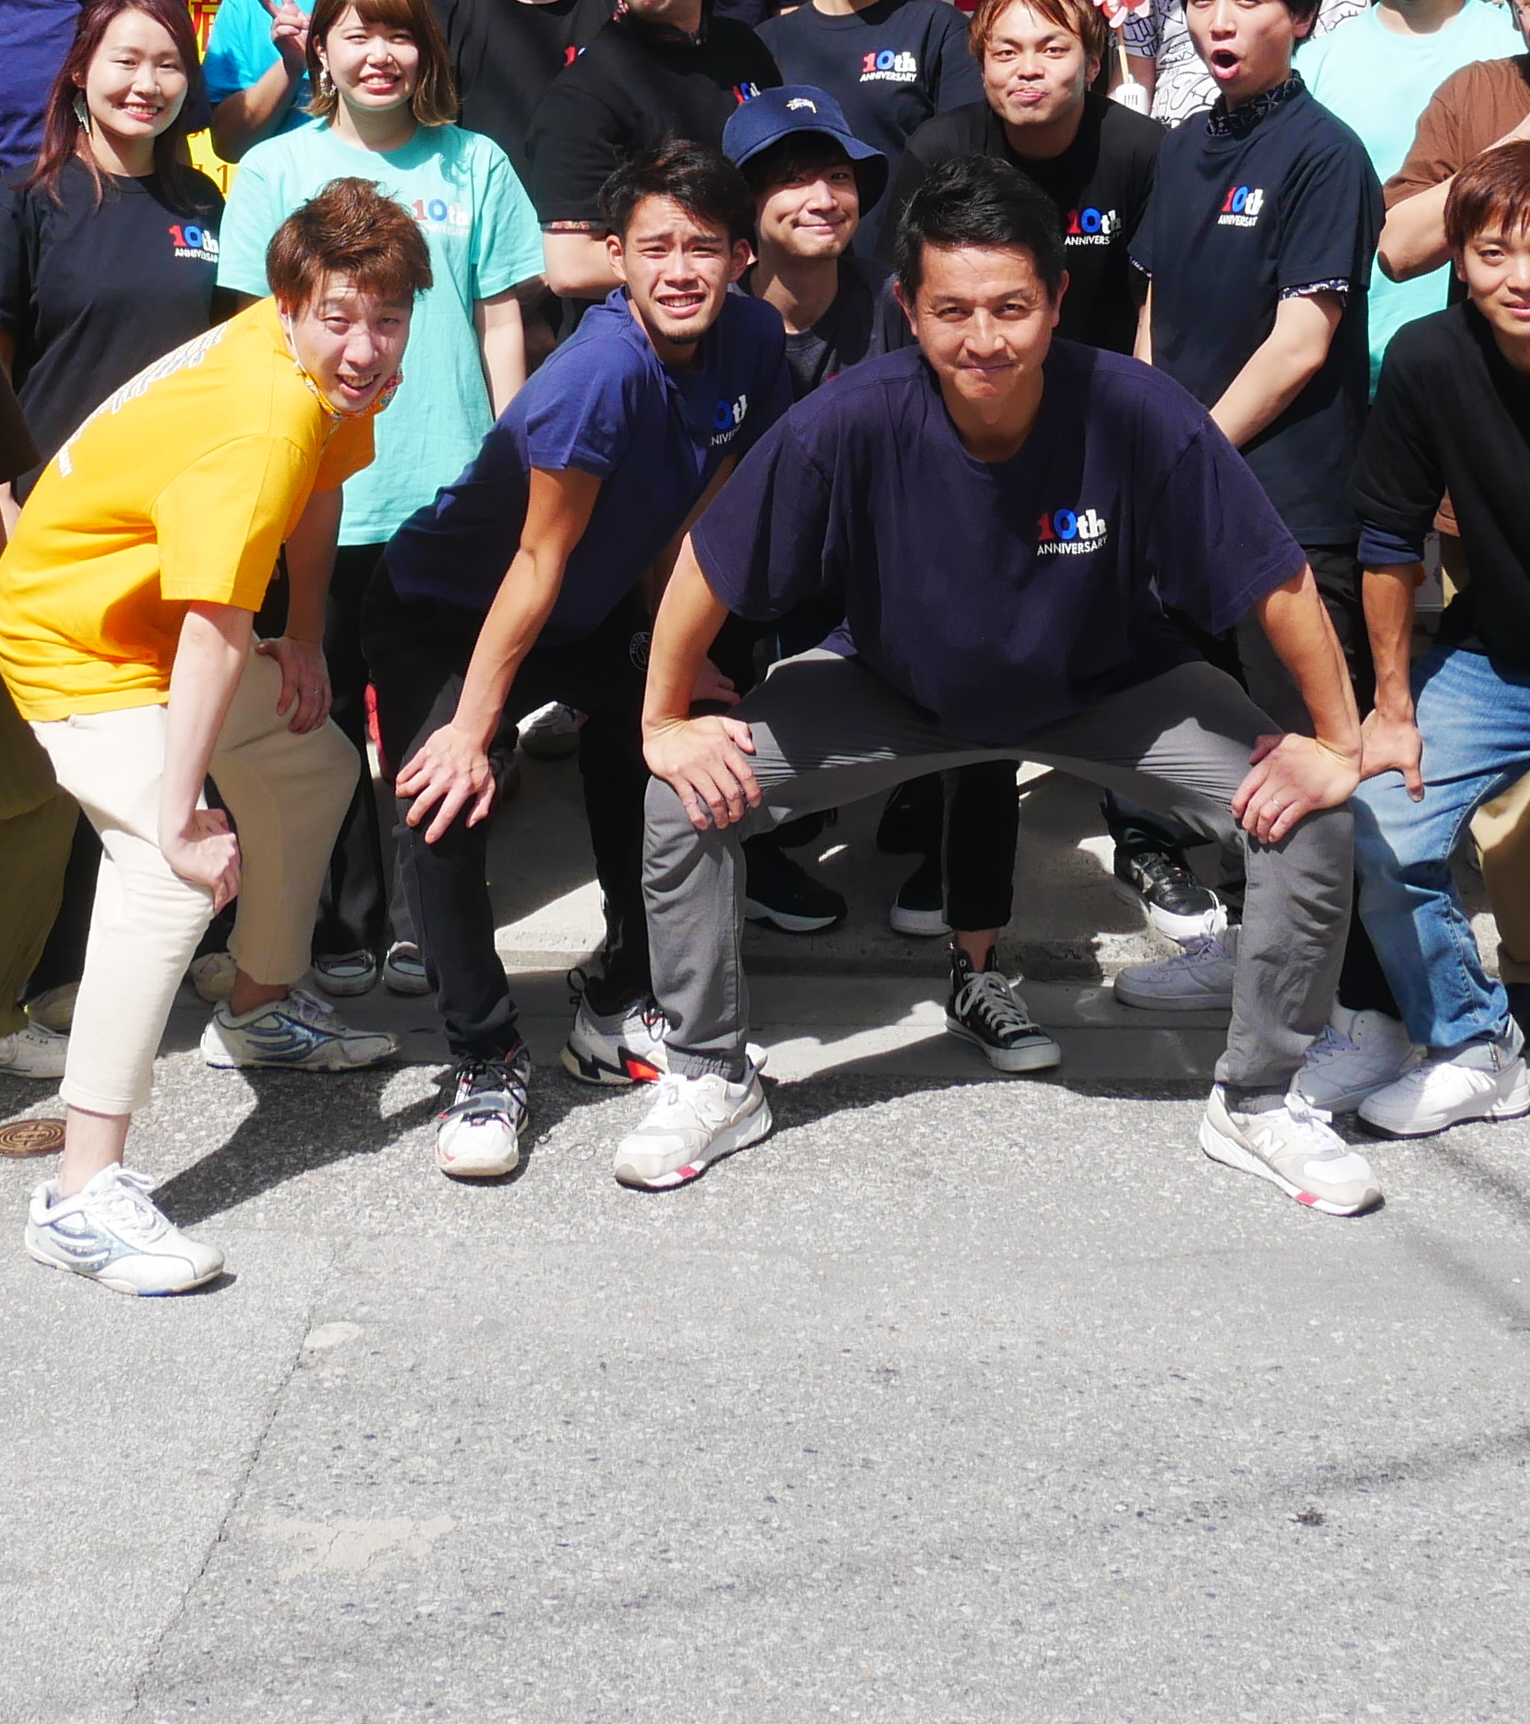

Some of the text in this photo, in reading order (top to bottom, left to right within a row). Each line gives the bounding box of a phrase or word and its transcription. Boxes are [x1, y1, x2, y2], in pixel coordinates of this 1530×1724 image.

[862, 51, 916, 73] 10th
[859, 71, 917, 82] ANNIVERSARY
[411, 199, 469, 226] 10th
[1221, 185, 1264, 216] 10th
[170, 224, 219, 254] 10th
[1037, 508, 1107, 541] 10th
[1036, 536, 1108, 556] ANNIVERSARY
